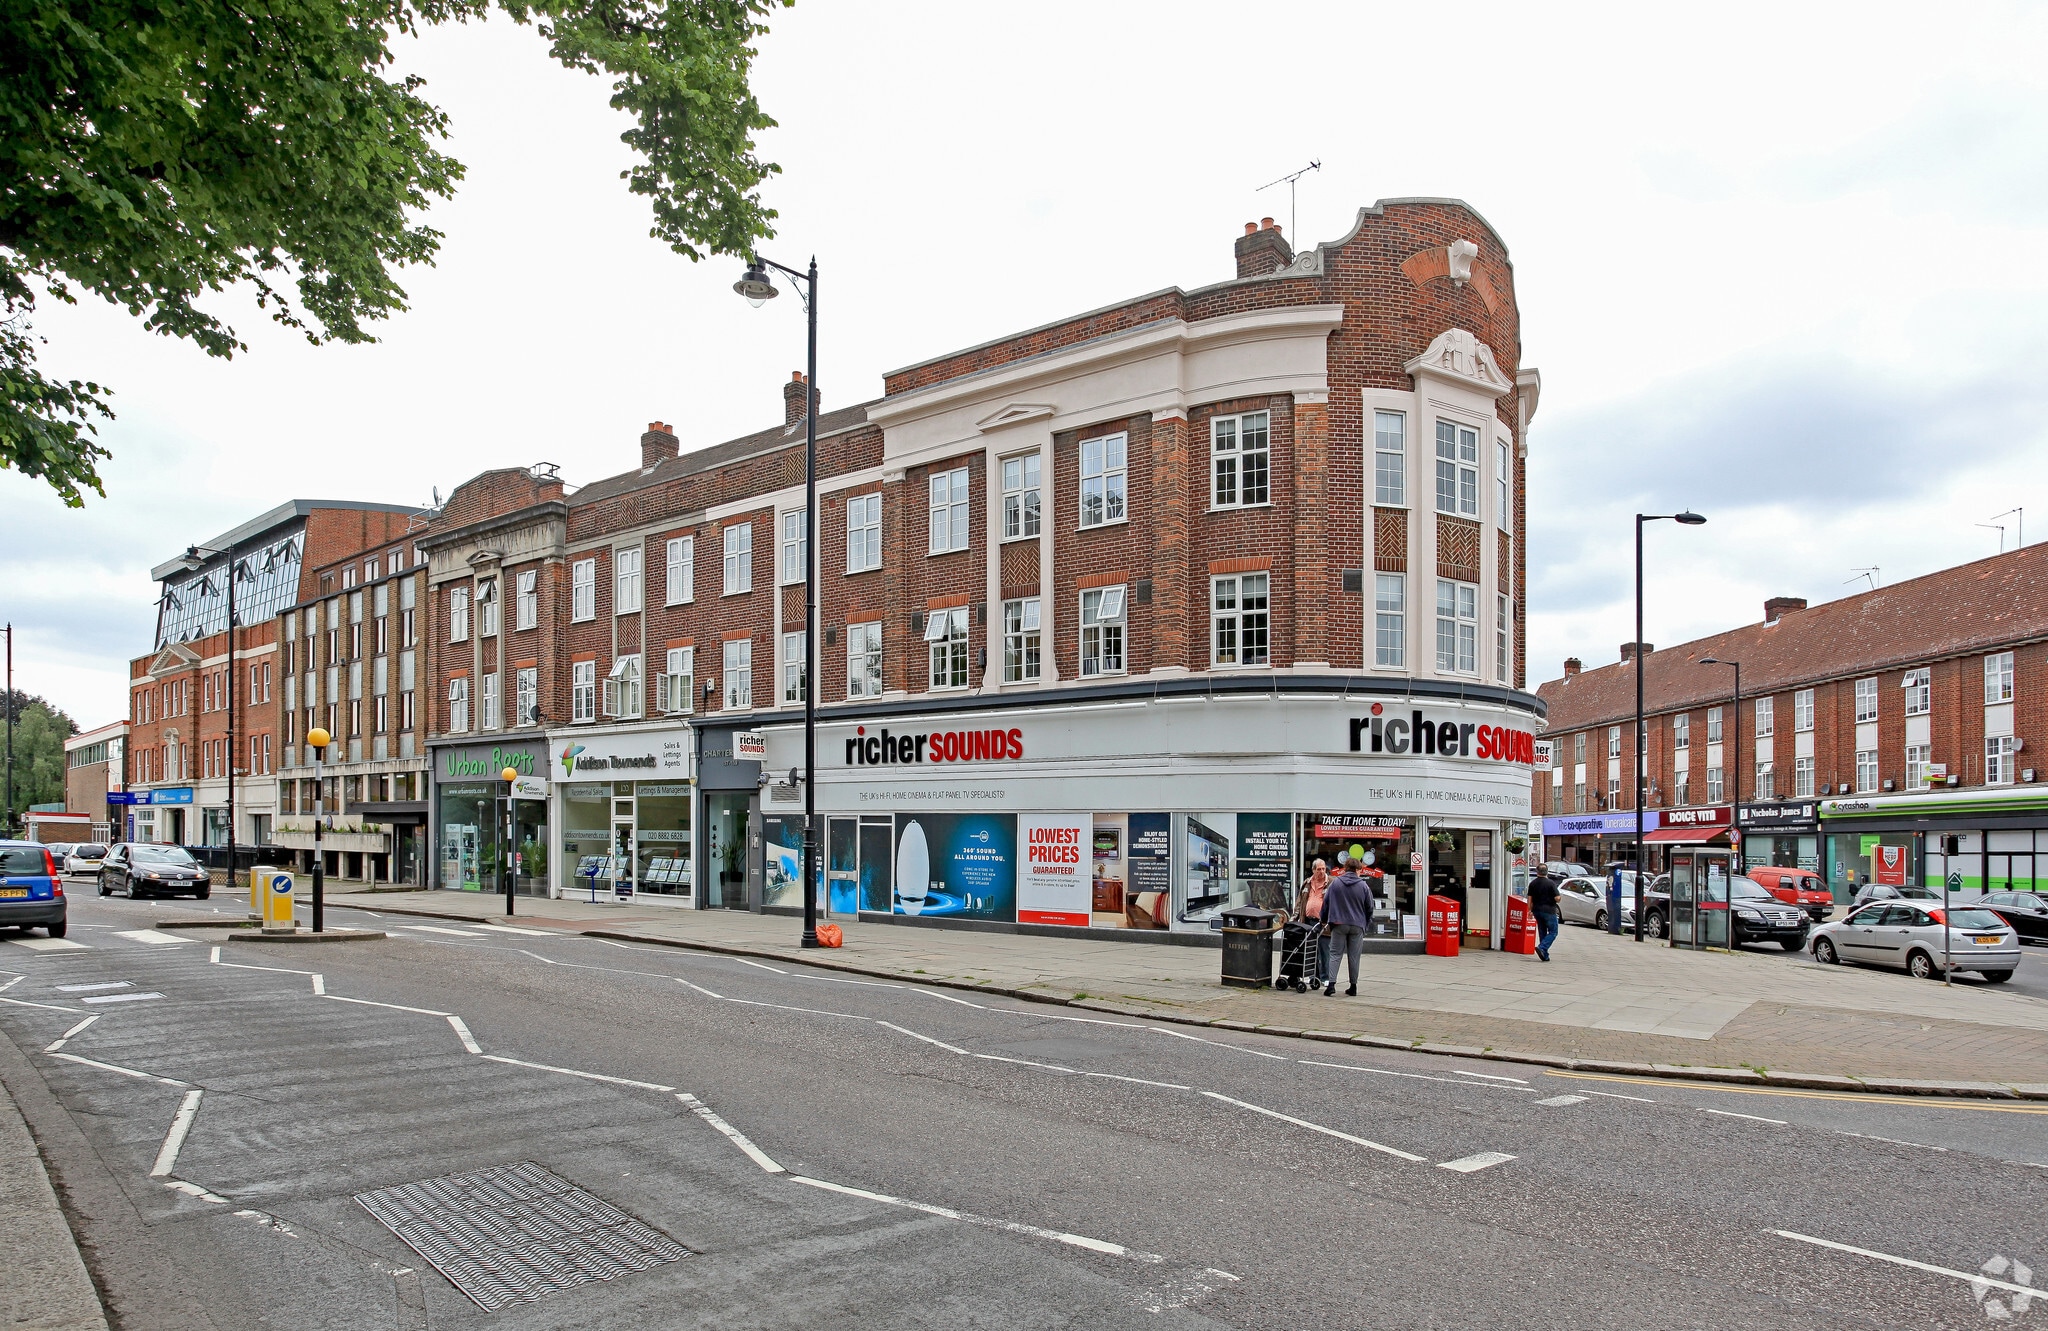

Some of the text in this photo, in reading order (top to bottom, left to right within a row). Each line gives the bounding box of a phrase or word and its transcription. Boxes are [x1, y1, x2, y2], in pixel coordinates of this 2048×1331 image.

[1349, 703, 1475, 756] richer
[664, 741, 681, 750] Sales &
[740, 734, 765, 746] richer
[845, 725, 1023, 765] richer SOUNDS
[740, 744, 765, 754] SOUNDS
[663, 750, 682, 760] Lettings
[447, 746, 535, 777] Urban Roots
[575, 753, 657, 771] Addison Townends
[664, 760, 681, 769] Agents
[639, 786, 657, 797] Lettings
[657, 786, 661, 795] &
[859, 792, 869, 801] THE
[893, 790, 907, 800] HOME
[908, 790, 927, 800] CINEMA
[928, 790, 932, 800] &
[932, 790, 945, 800] FLAT
[945, 790, 961, 799] PANEL
[962, 790, 970, 799] TV
[1368, 788, 1384, 800] THE
[1386, 789, 1403, 799] UK's
[1405, 790, 1413, 799] HI
[1415, 789, 1425, 800] FI,
[1426, 790, 1444, 801] HOME
[1444, 791, 1467, 802] CINEMA
[1467, 793, 1472, 803] &
[1473, 793, 1486, 804] FLAT
[1486, 794, 1504, 805] PANEL
[1504, 795, 1512, 805] TV
[1750, 806, 1801, 818] Nicholas James
[1837, 801, 1869, 812] cytashop
[1322, 815, 1406, 828] TAKE IT HOME TODAY!
[1669, 809, 1716, 823] DOLCE VITA
[1558, 815, 1637, 833] The co-operative funeralcare
[648, 831, 657, 840] 020
[657, 831, 670, 840] 8882
[1029, 827, 1081, 844] LOWEST
[1266, 837, 1280, 845] YOUR
[1280, 838, 1289, 846] TV,
[1028, 845, 1080, 864] PRICES
[1032, 865, 1075, 875] GUARANTEED!
[1430, 910, 1444, 918] FREE
[1447, 911, 1459, 919] FREE
[1510, 909, 1523, 917] FREE
